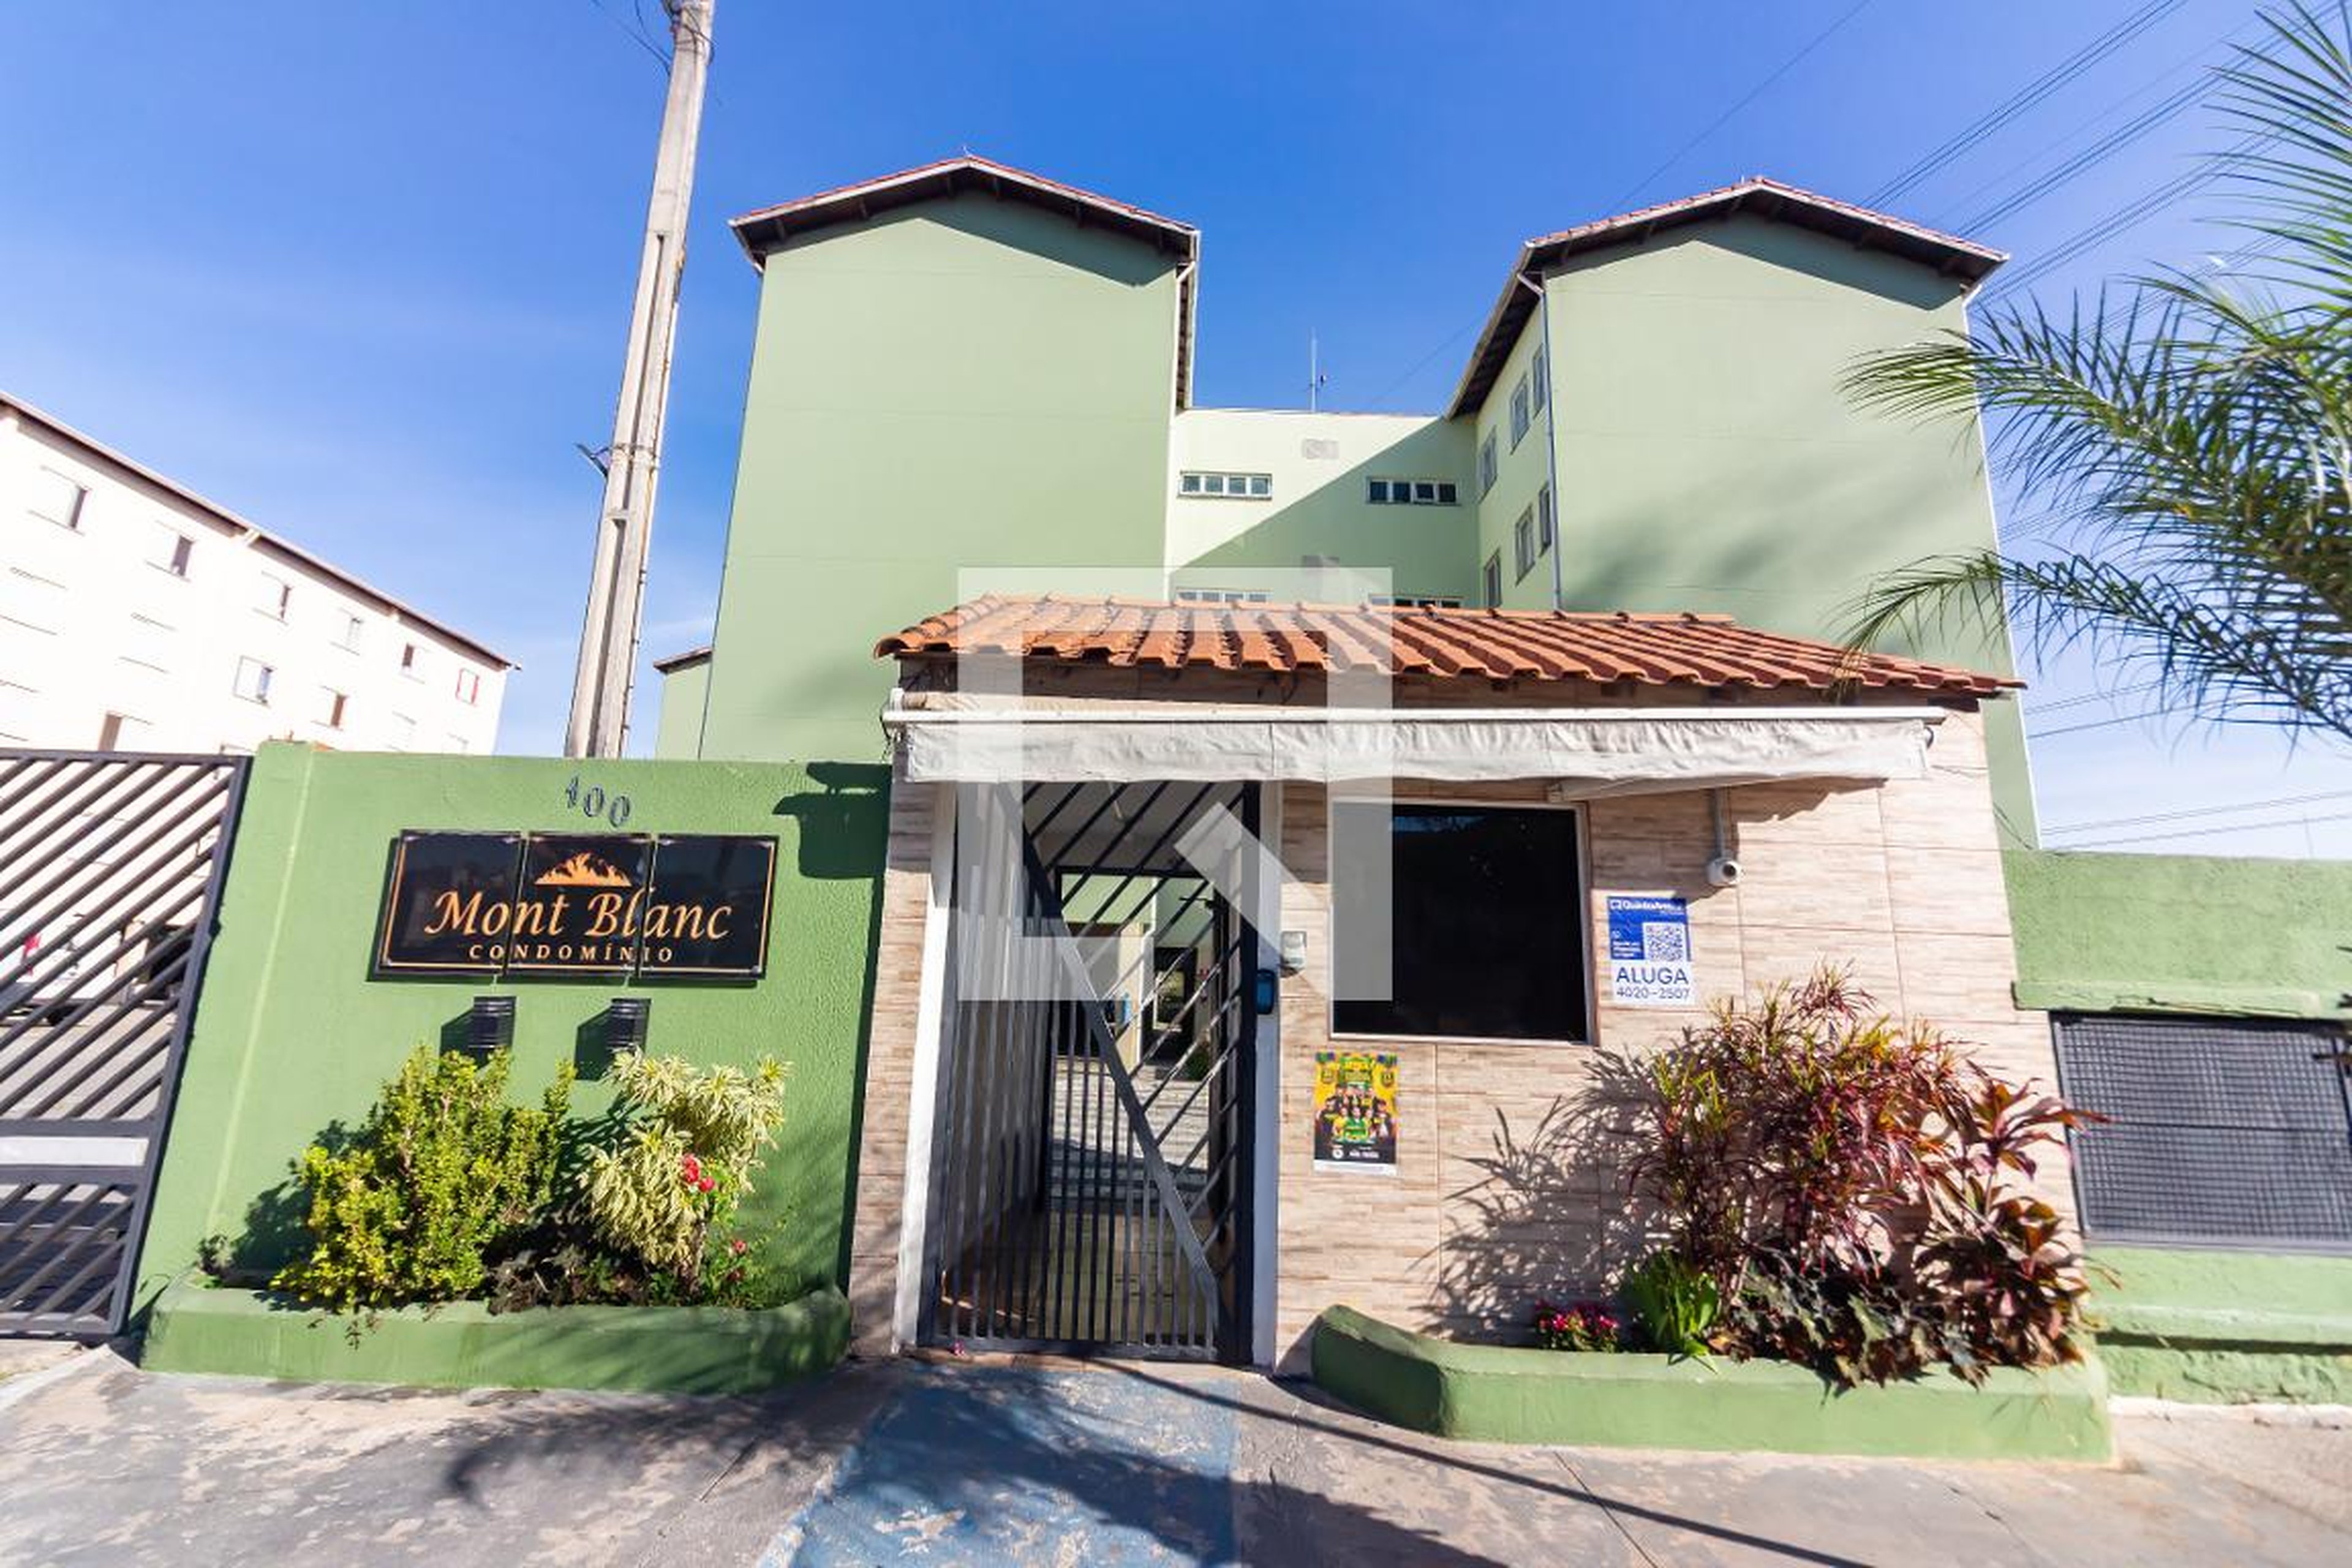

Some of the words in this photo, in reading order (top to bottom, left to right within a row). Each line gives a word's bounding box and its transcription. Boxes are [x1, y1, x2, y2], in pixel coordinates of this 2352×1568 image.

[424, 891, 570, 936] Mont
[584, 887, 732, 940] Blanc
[469, 943, 673, 962] CONDOMÍNIO
[1616, 967, 1689, 985] ALUGA
[1616, 987, 1689, 1000] 4020-2507
